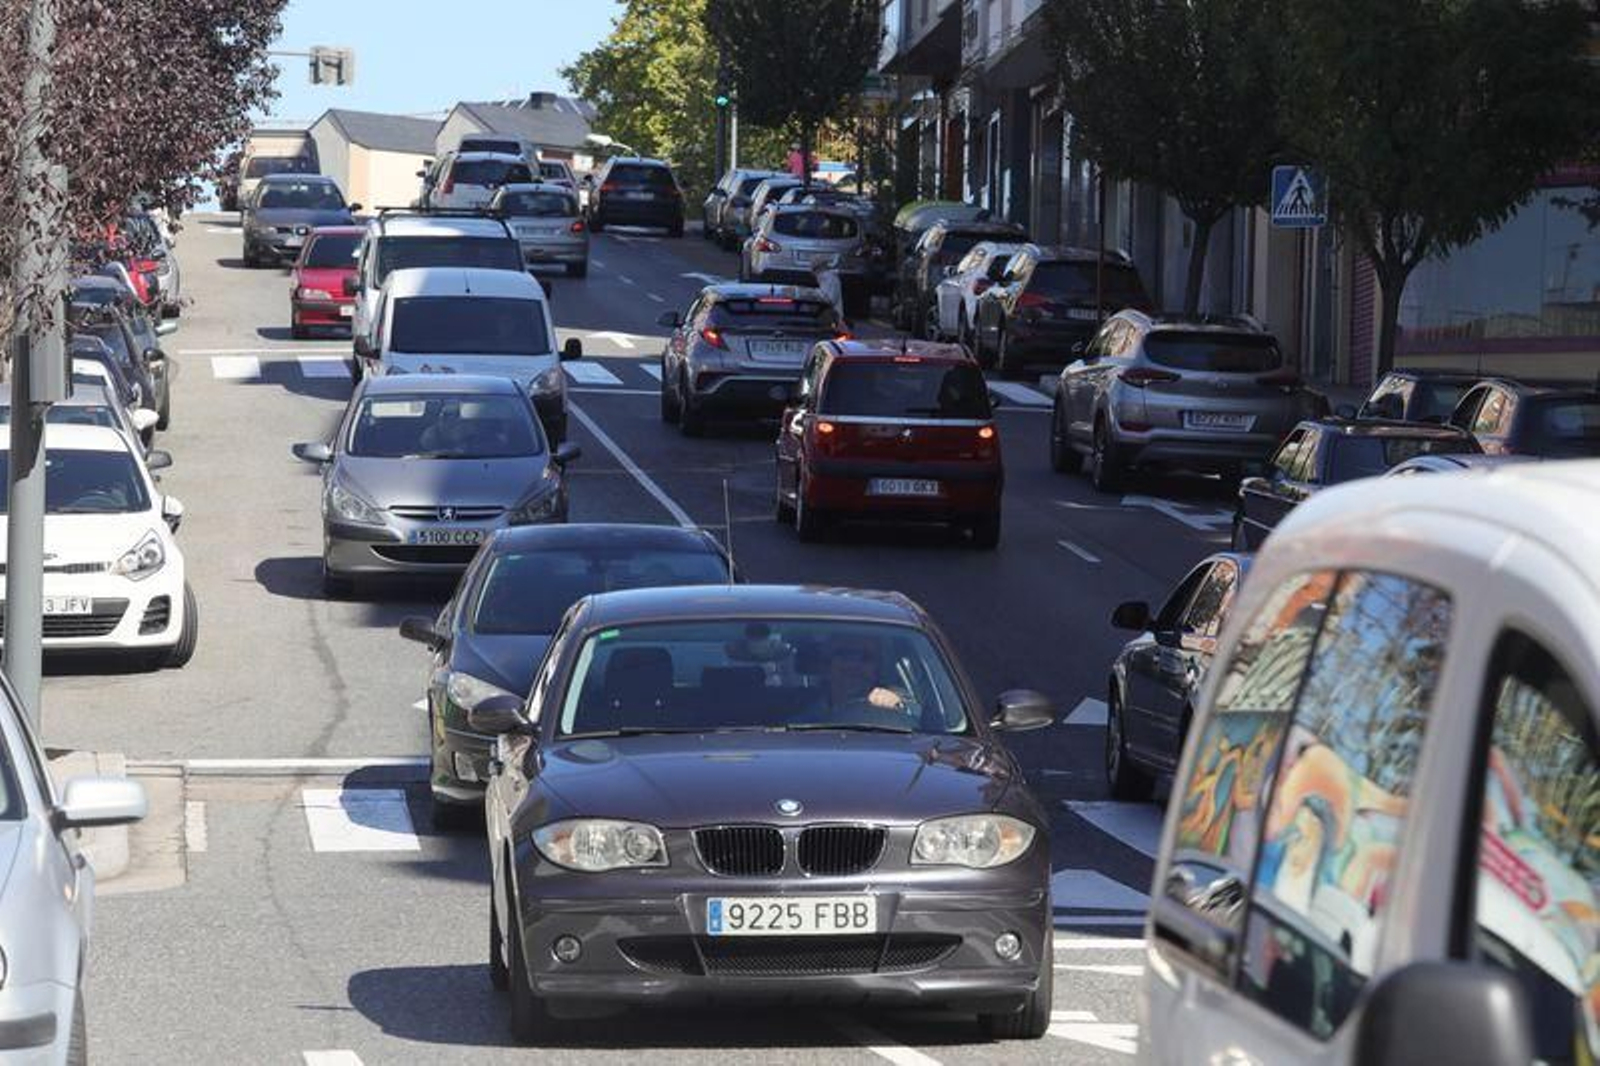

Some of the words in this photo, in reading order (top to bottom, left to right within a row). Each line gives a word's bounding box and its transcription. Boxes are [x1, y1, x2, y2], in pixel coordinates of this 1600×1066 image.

[419, 530, 450, 544] 5100
[61, 598, 89, 612] JFV
[729, 903, 803, 930] 9225
[814, 902, 869, 929] FBB
